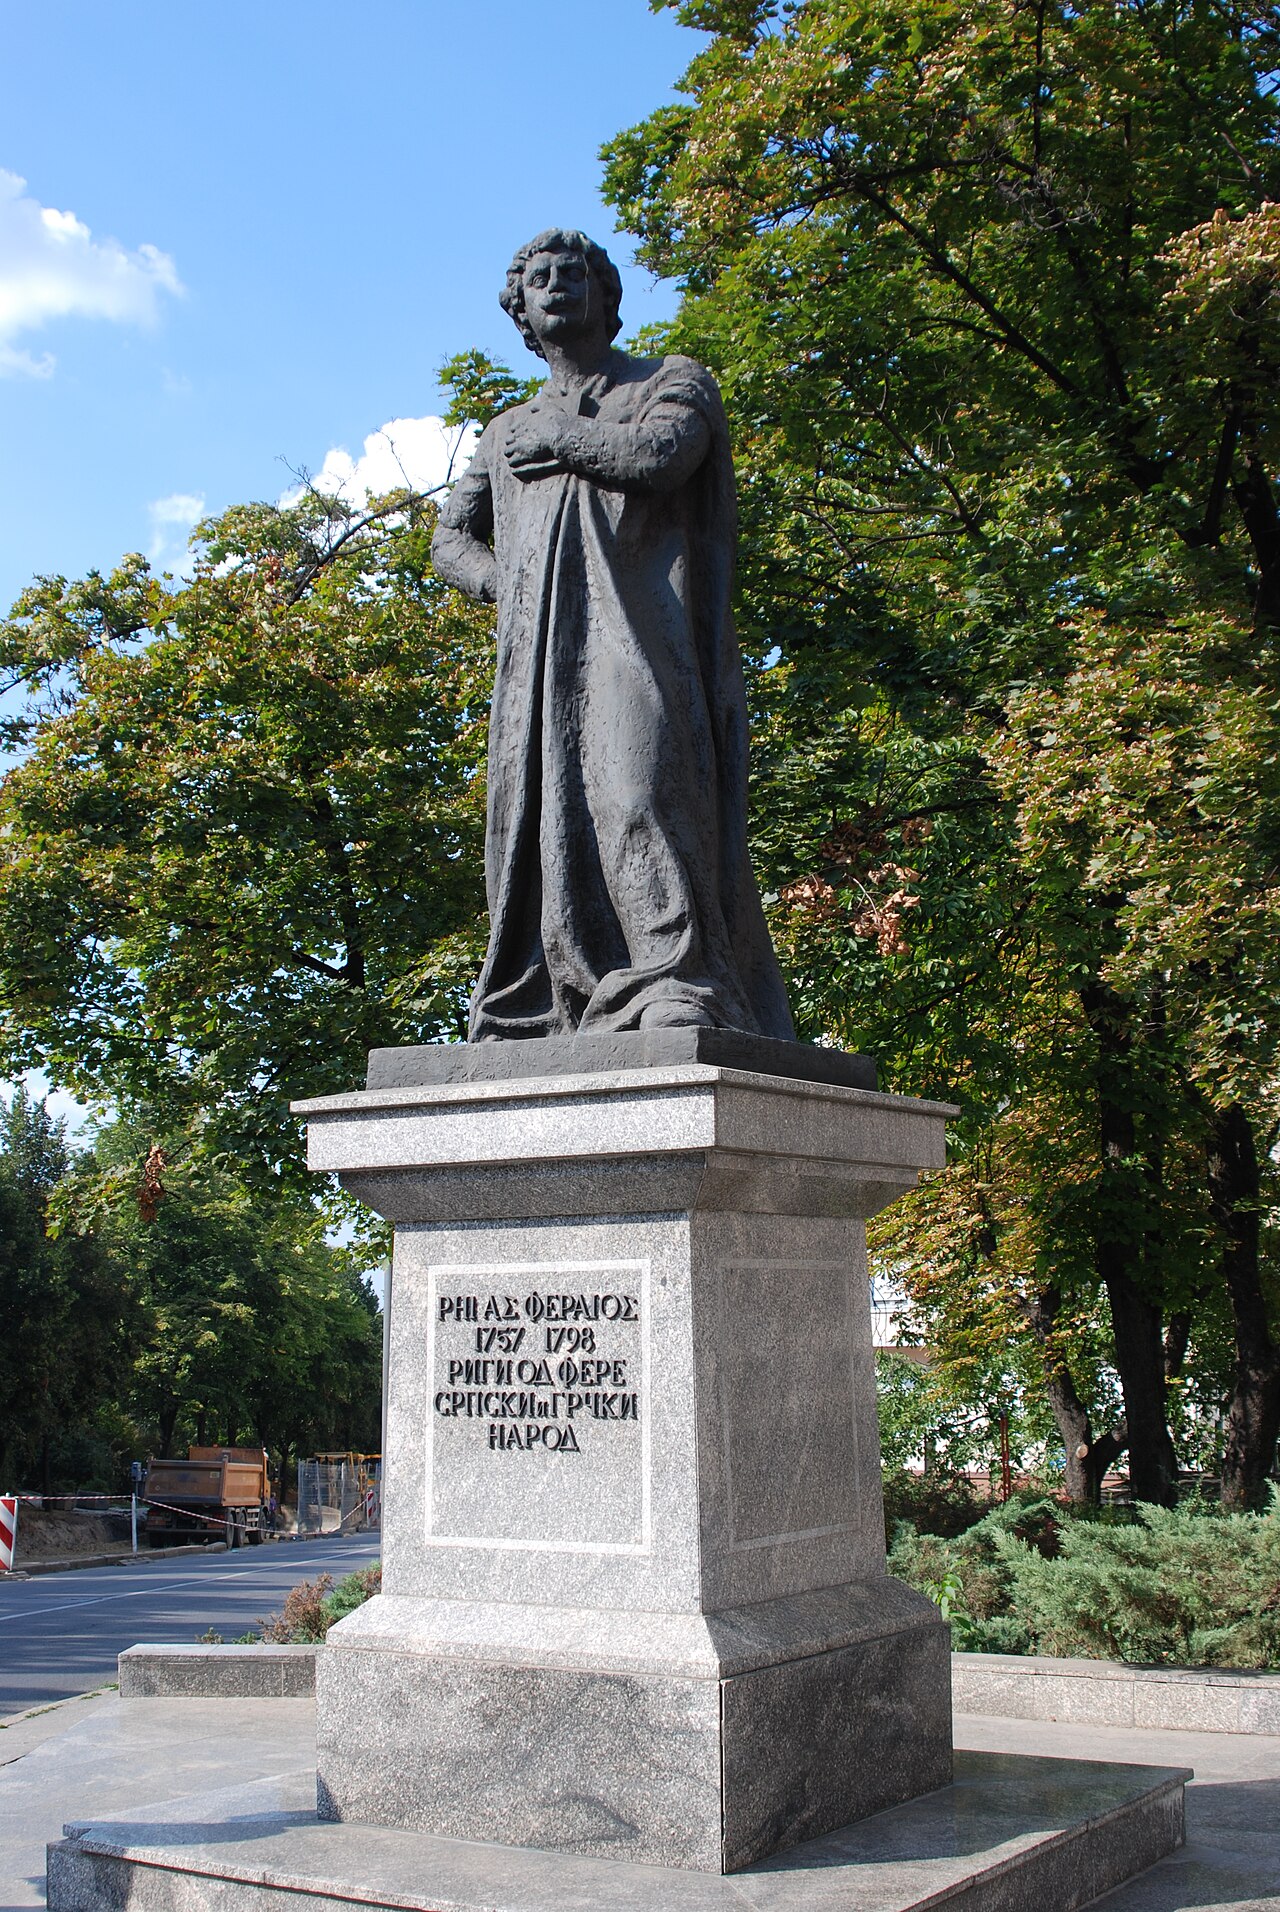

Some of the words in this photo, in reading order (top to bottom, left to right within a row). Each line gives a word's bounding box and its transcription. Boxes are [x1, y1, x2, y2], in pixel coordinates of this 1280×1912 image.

[475, 1326, 526, 1353] 1757
[545, 1326, 597, 1354] 1798
[447, 1358, 513, 1386] РИГИ
[517, 1358, 555, 1387] ОД
[557, 1356, 627, 1389] ФЕРЕ
[433, 1391, 536, 1418] СРПСКИ
[550, 1391, 639, 1420] ГРЧКИ
[487, 1422, 581, 1453] НАРОД
